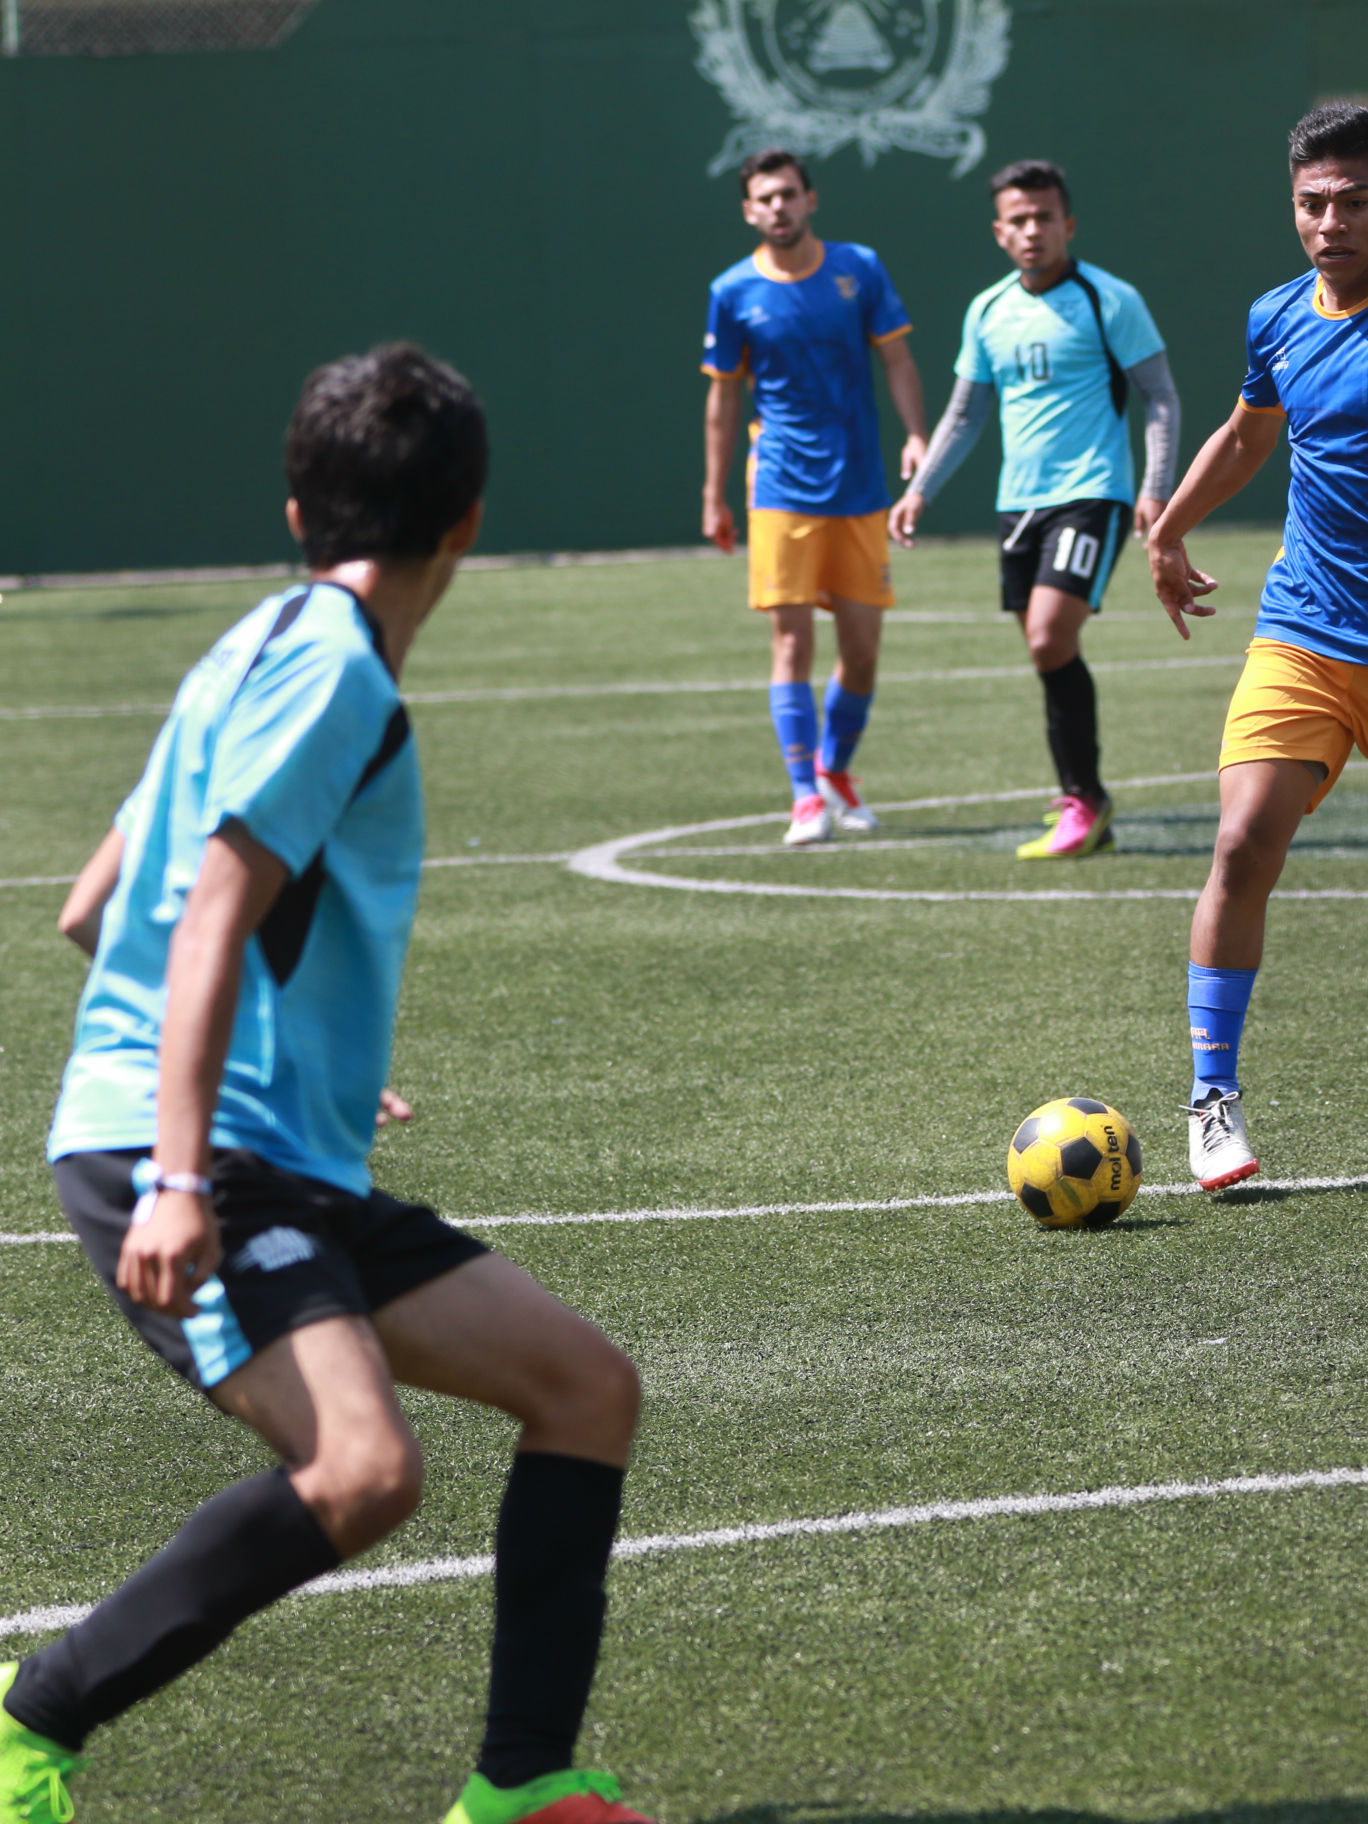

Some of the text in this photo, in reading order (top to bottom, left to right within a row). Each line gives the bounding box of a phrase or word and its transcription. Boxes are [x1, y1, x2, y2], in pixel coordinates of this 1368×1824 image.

[1015, 343, 1049, 381] 10
[1053, 527, 1099, 580] 10
[1104, 1125, 1121, 1190] molten
